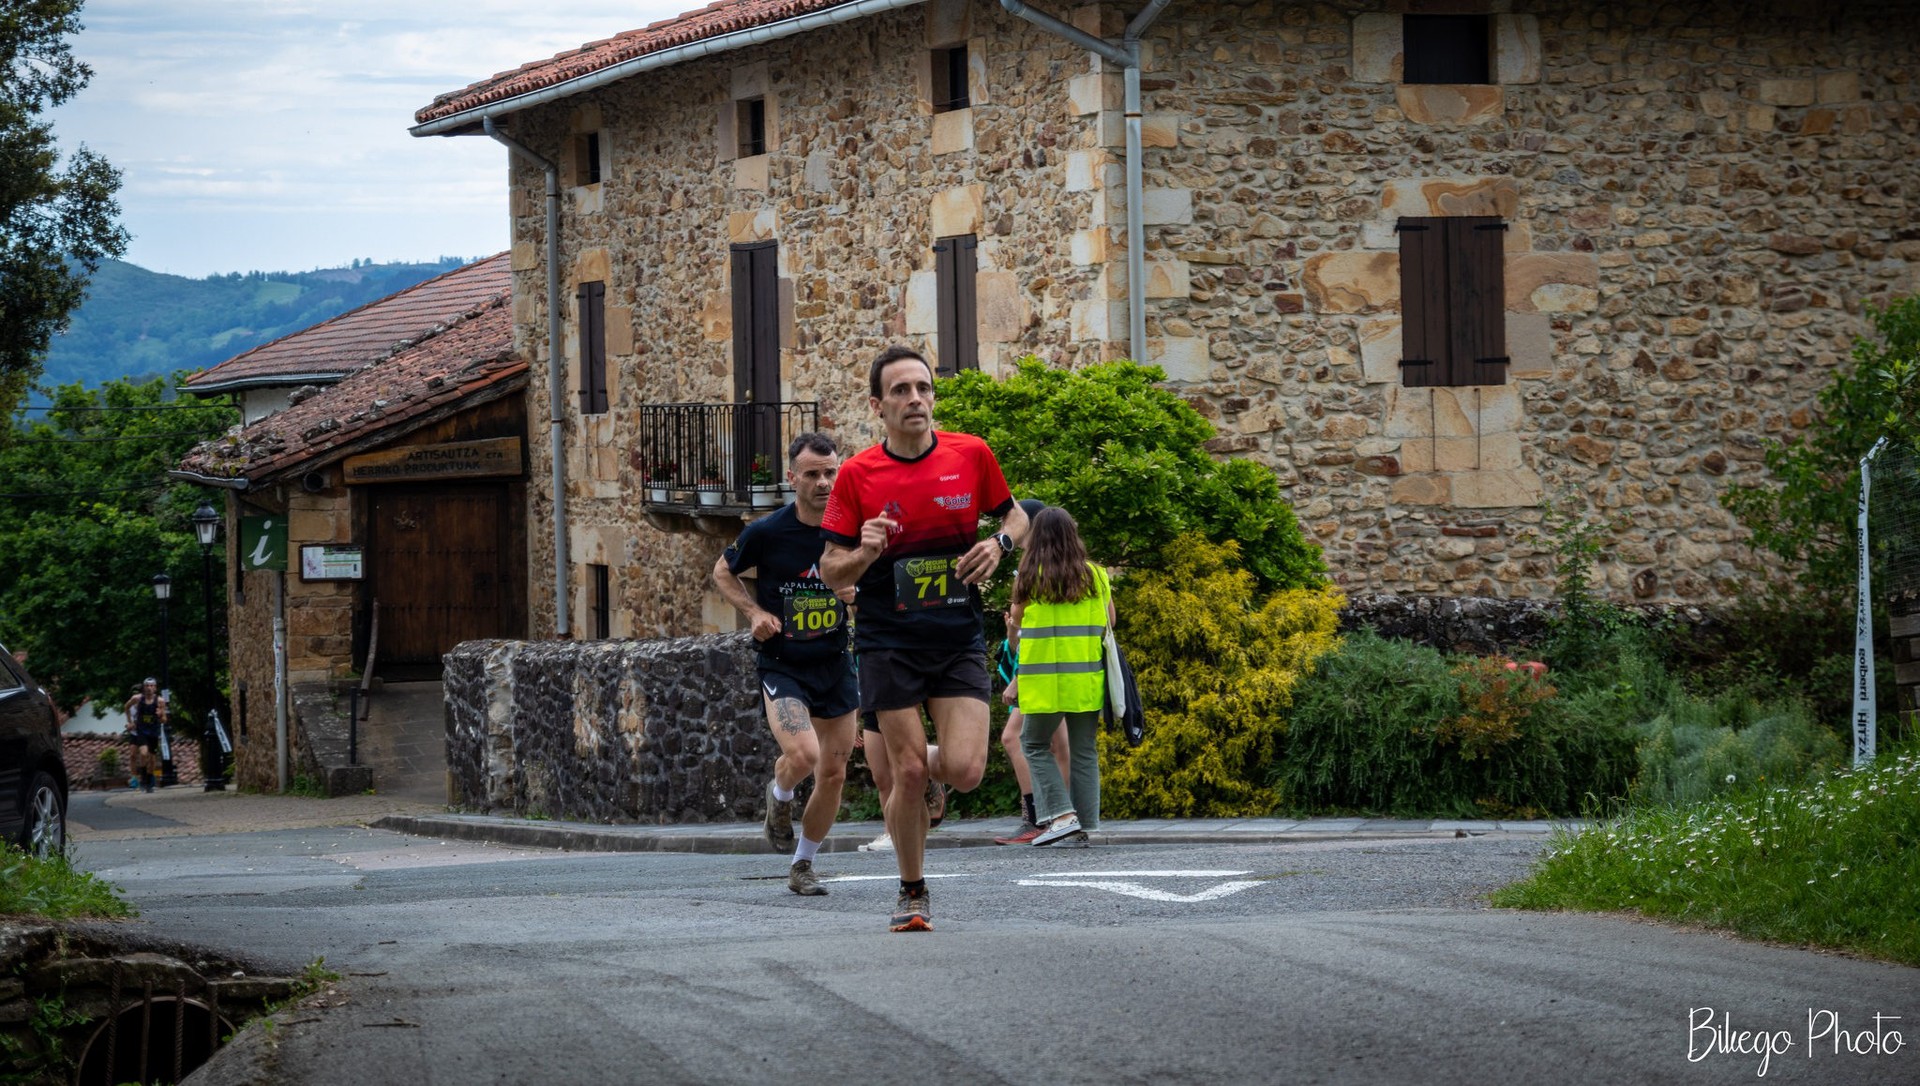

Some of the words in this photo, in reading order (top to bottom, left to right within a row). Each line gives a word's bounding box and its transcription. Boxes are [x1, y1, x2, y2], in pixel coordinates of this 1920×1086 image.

[407, 450, 479, 462] ARTISAUTZA
[353, 464, 399, 477] HERRIKO
[405, 461, 481, 474] PRODUKTUAK
[914, 574, 947, 599] 71
[792, 610, 837, 630] 100
[1857, 648, 1868, 700] goiberri
[1856, 712, 1867, 757] HITZA
